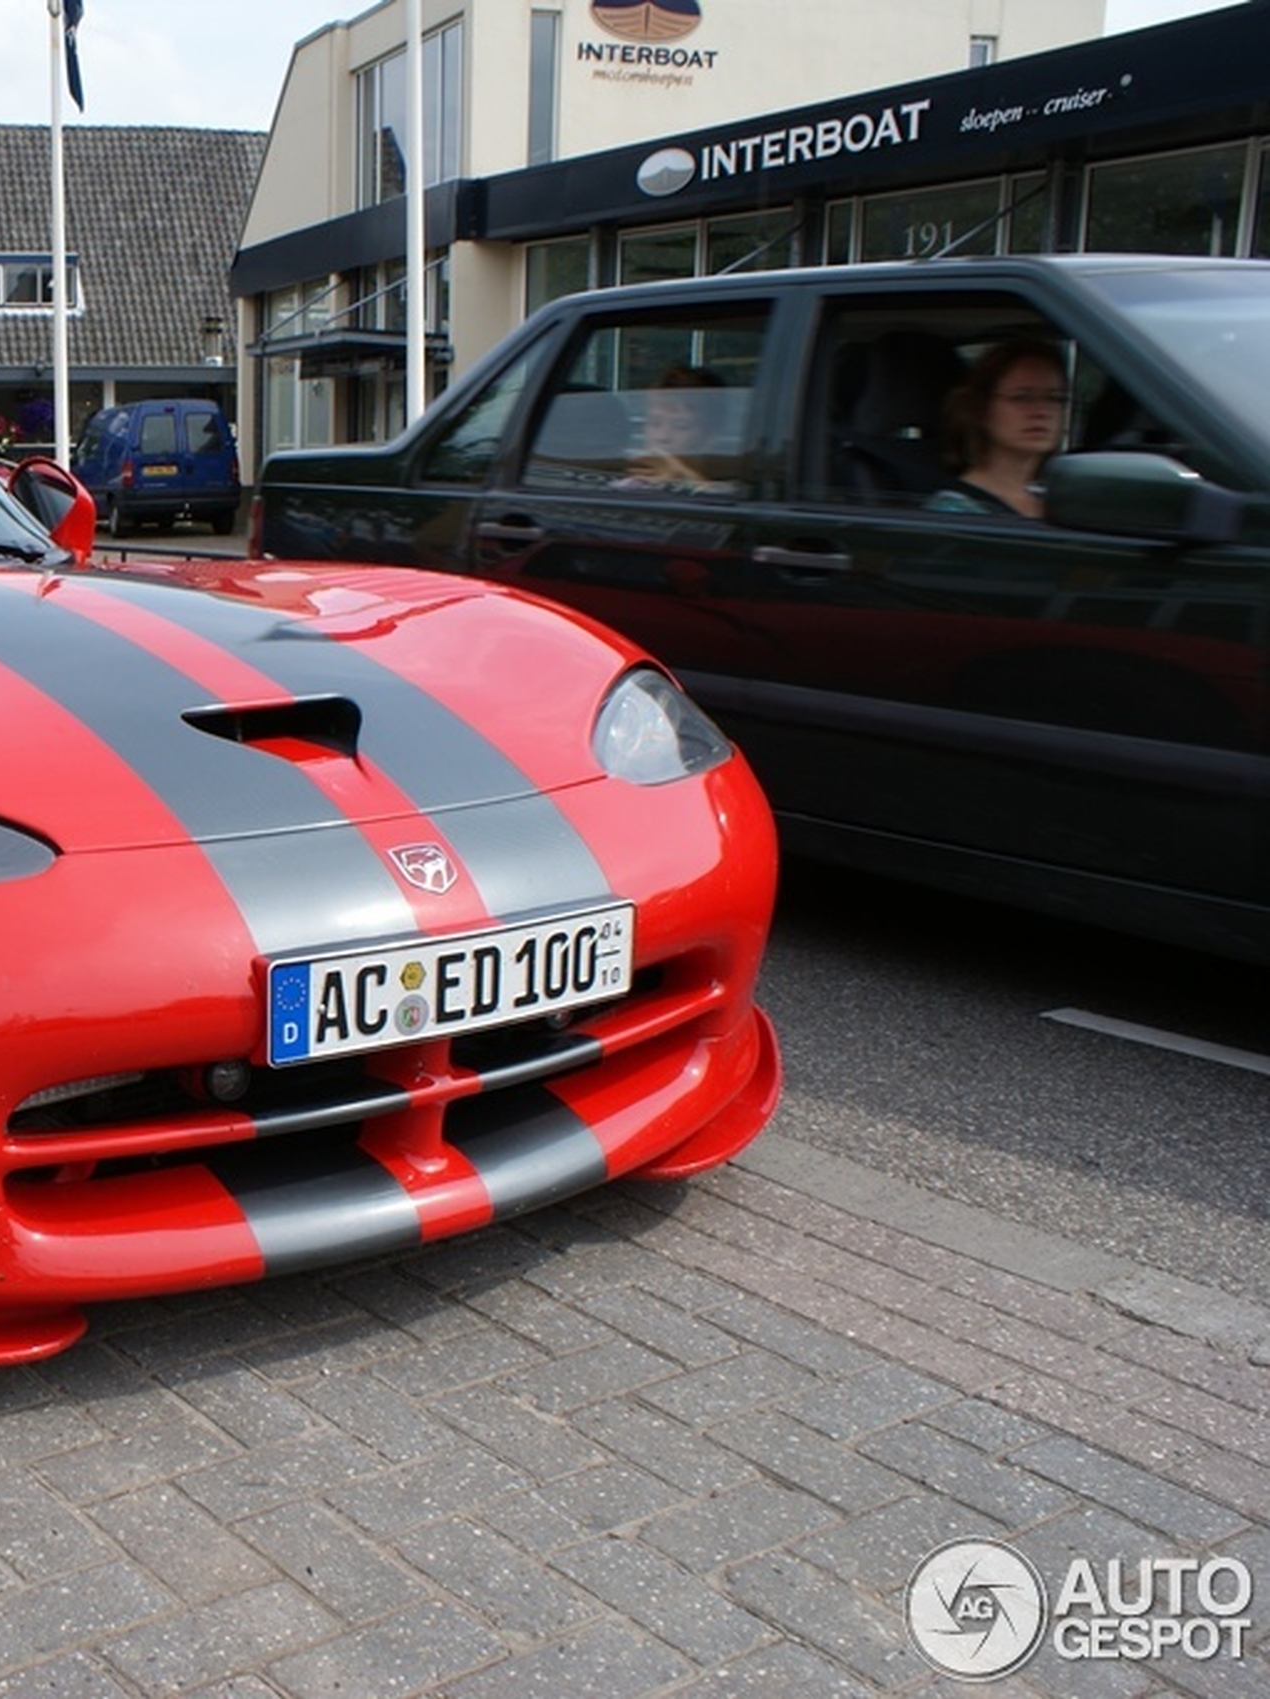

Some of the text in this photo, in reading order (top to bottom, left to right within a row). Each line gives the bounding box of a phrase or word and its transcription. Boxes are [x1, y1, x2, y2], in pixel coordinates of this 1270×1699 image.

[577, 42, 718, 69] INTERBOAT
[959, 106, 1024, 133] sloepen
[701, 99, 931, 182] INTERBOAT
[904, 221, 954, 257] 191
[316, 963, 389, 1044] AC
[282, 1022, 299, 1044] D
